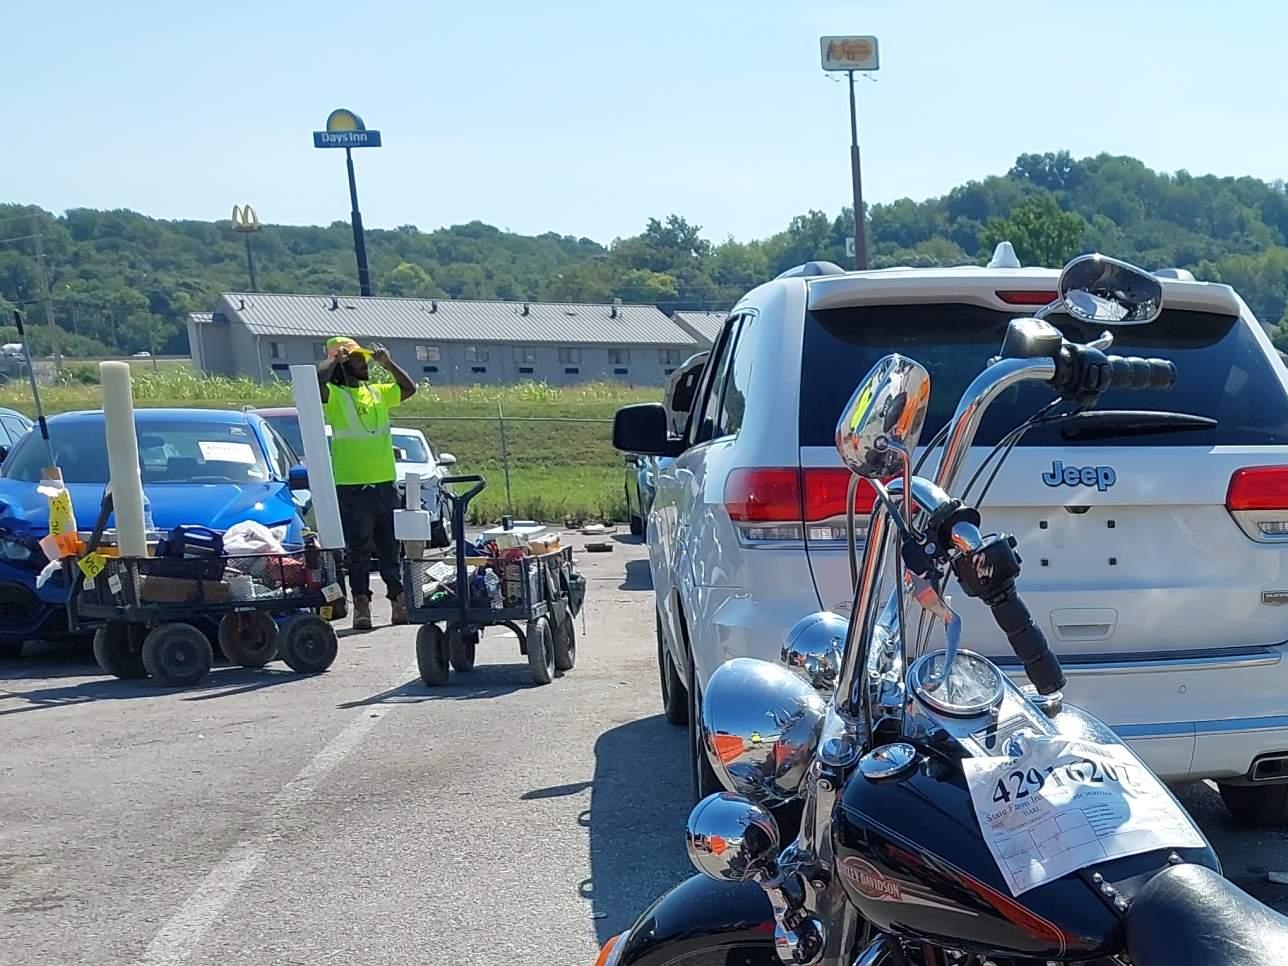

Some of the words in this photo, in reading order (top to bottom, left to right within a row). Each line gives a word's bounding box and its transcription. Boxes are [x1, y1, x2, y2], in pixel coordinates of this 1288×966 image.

[1042, 461, 1117, 491] Jeep
[84, 556, 100, 575] VIC
[986, 808, 1008, 823] State
[1008, 799, 1030, 813] Farm
